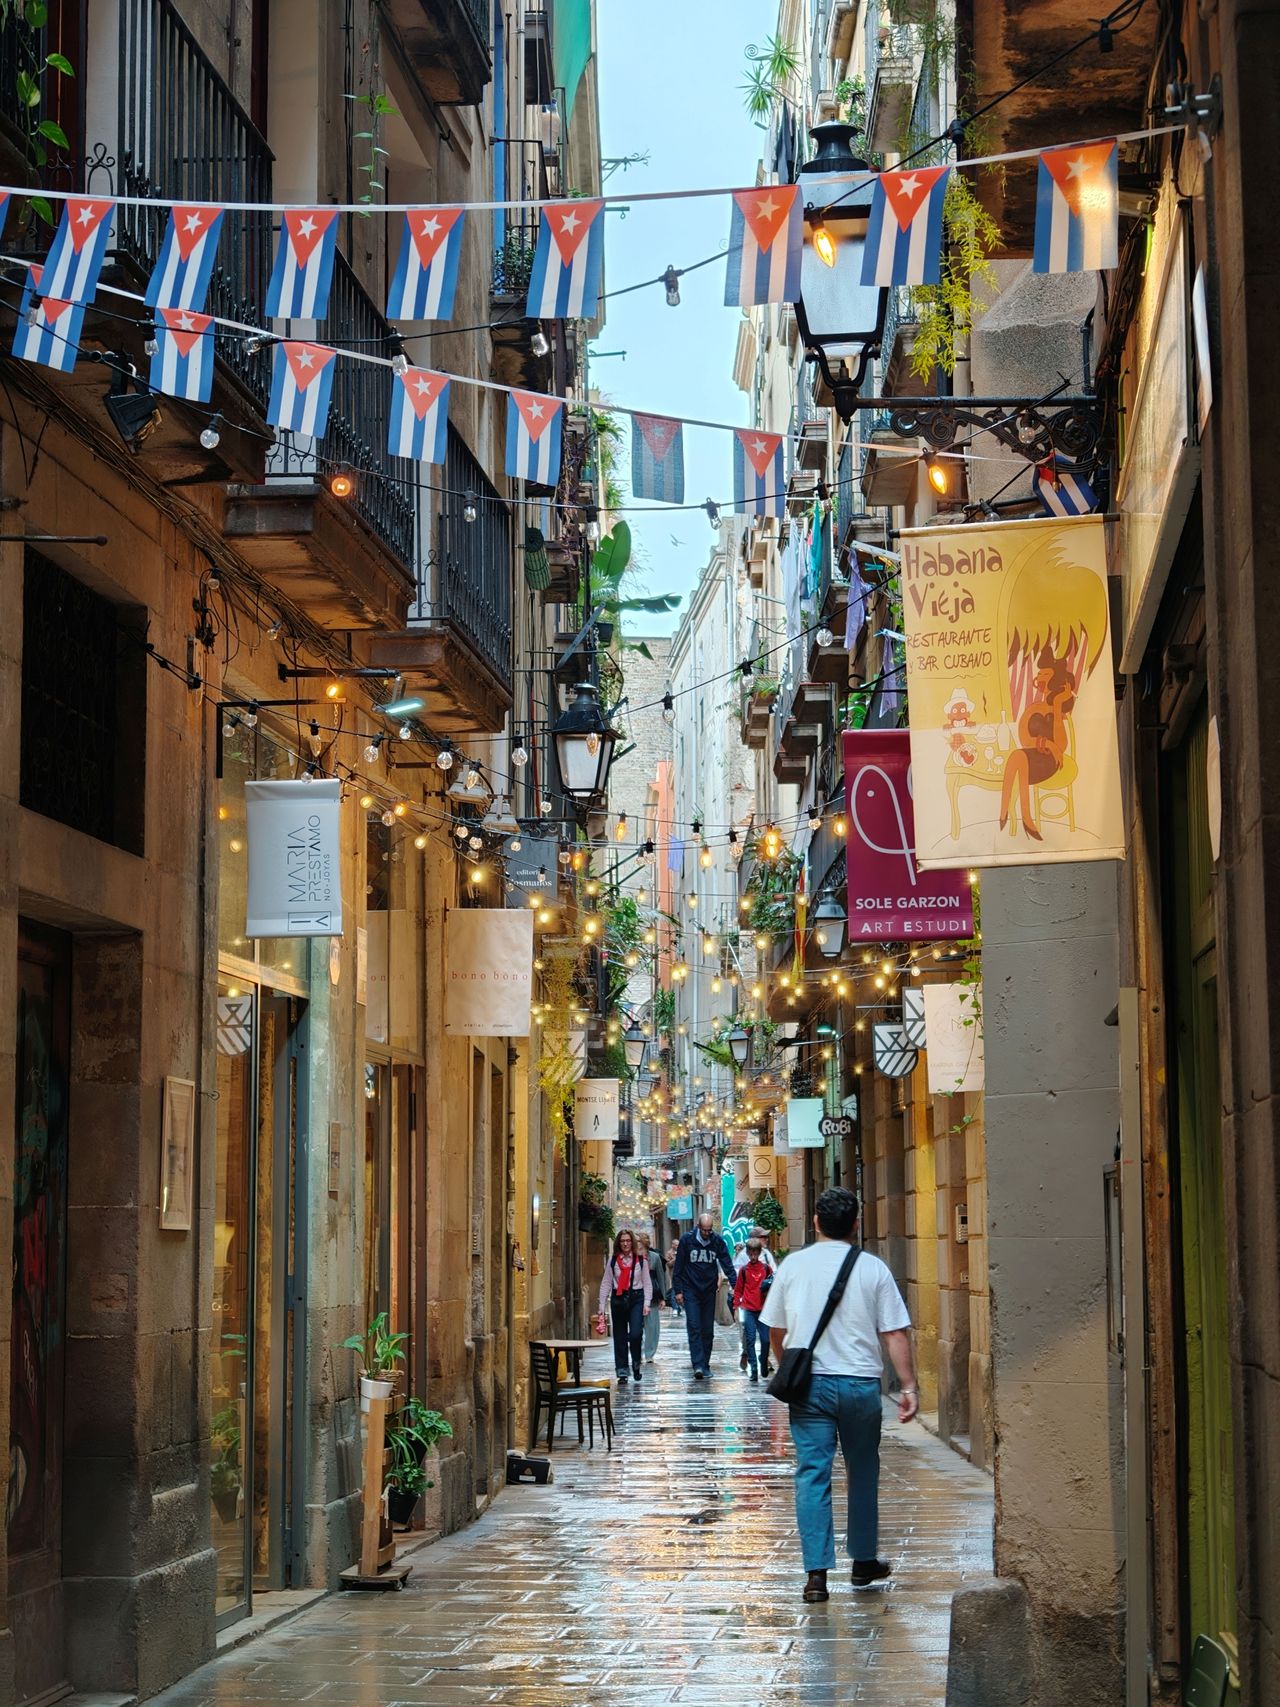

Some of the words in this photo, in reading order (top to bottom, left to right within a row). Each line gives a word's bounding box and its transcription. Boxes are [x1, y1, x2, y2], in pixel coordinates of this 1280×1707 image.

[905, 542, 1003, 581] Habana
[909, 581, 975, 623] Vieja
[906, 628, 992, 648] RESTAURANTE
[917, 655, 939, 672] BAR
[944, 651, 992, 670] CUBANO
[287, 827, 306, 902] MARIA
[308, 815, 322, 902] PRESTAMO
[855, 897, 893, 910] SOLE
[897, 895, 960, 909] GARZON
[861, 921, 894, 933] ART
[904, 920, 967, 932] ESTUDI
[452, 970, 487, 980] bono
[493, 970, 528, 981] bono
